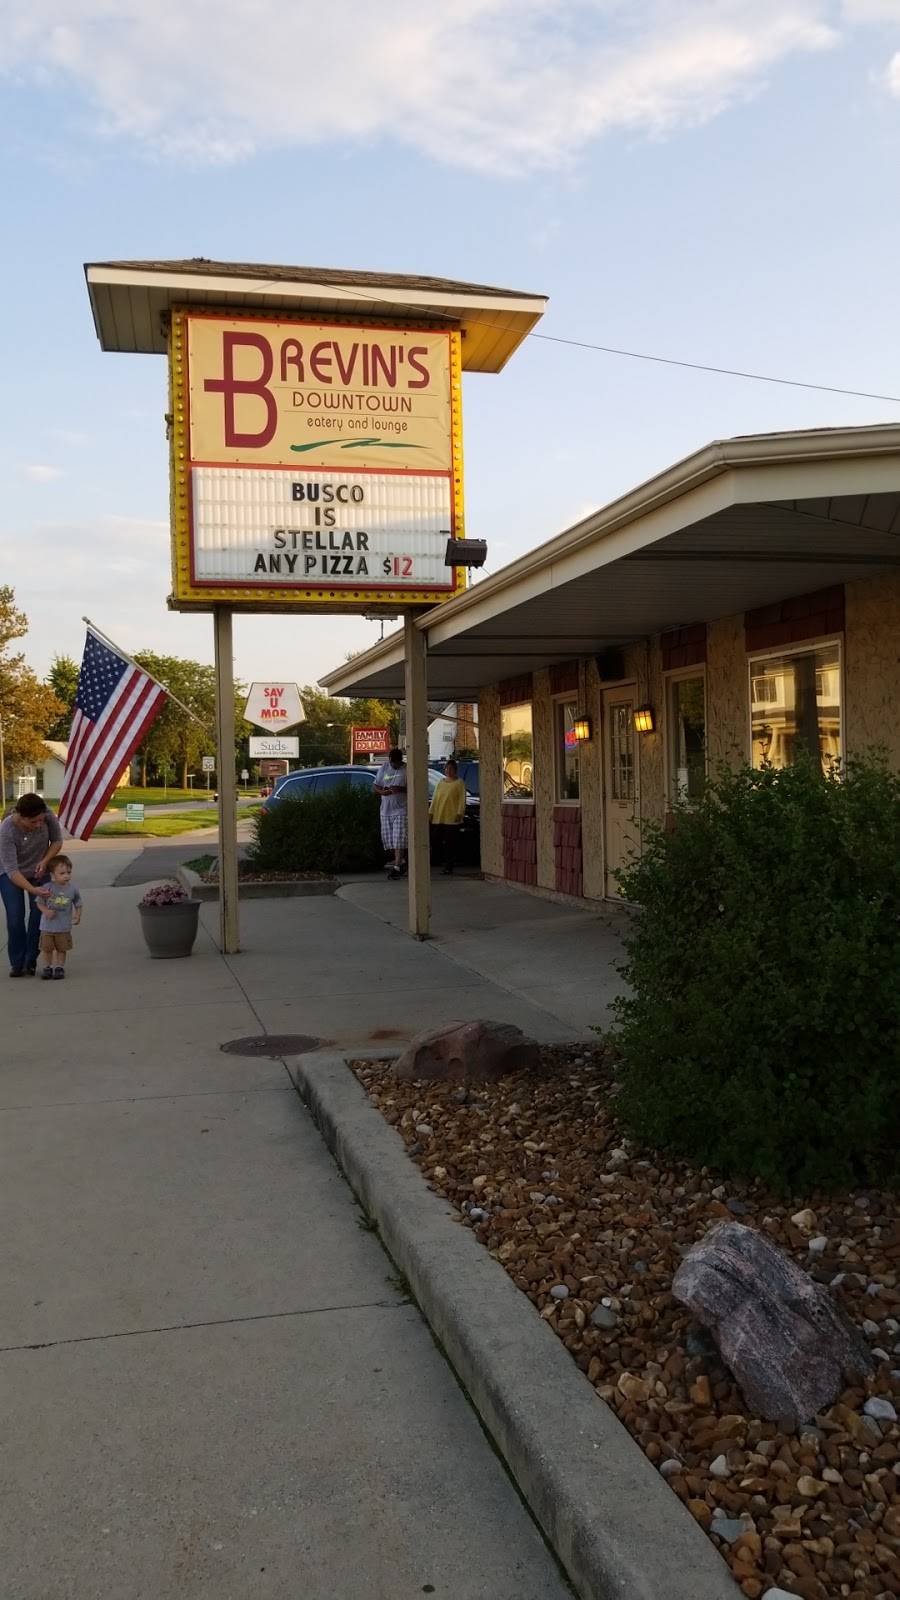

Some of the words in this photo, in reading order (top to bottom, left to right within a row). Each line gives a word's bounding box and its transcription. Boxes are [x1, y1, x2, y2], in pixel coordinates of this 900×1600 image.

[204, 331, 430, 448] BREVIN'S
[292, 391, 412, 412] DOWNTOWN
[307, 417, 343, 431] eatery
[347, 417, 368, 430] and
[371, 418, 408, 433] lounge
[292, 483, 364, 503] BUSCO
[315, 507, 336, 526] IS
[274, 530, 369, 551] STELLAR
[383, 556, 413, 576] $12
[264, 688, 284, 697] SAV
[270, 697, 279, 708] U
[261, 709, 287, 718] MOR
[355, 730, 386, 740] FAMILY
[260, 740, 286, 751] Suds
